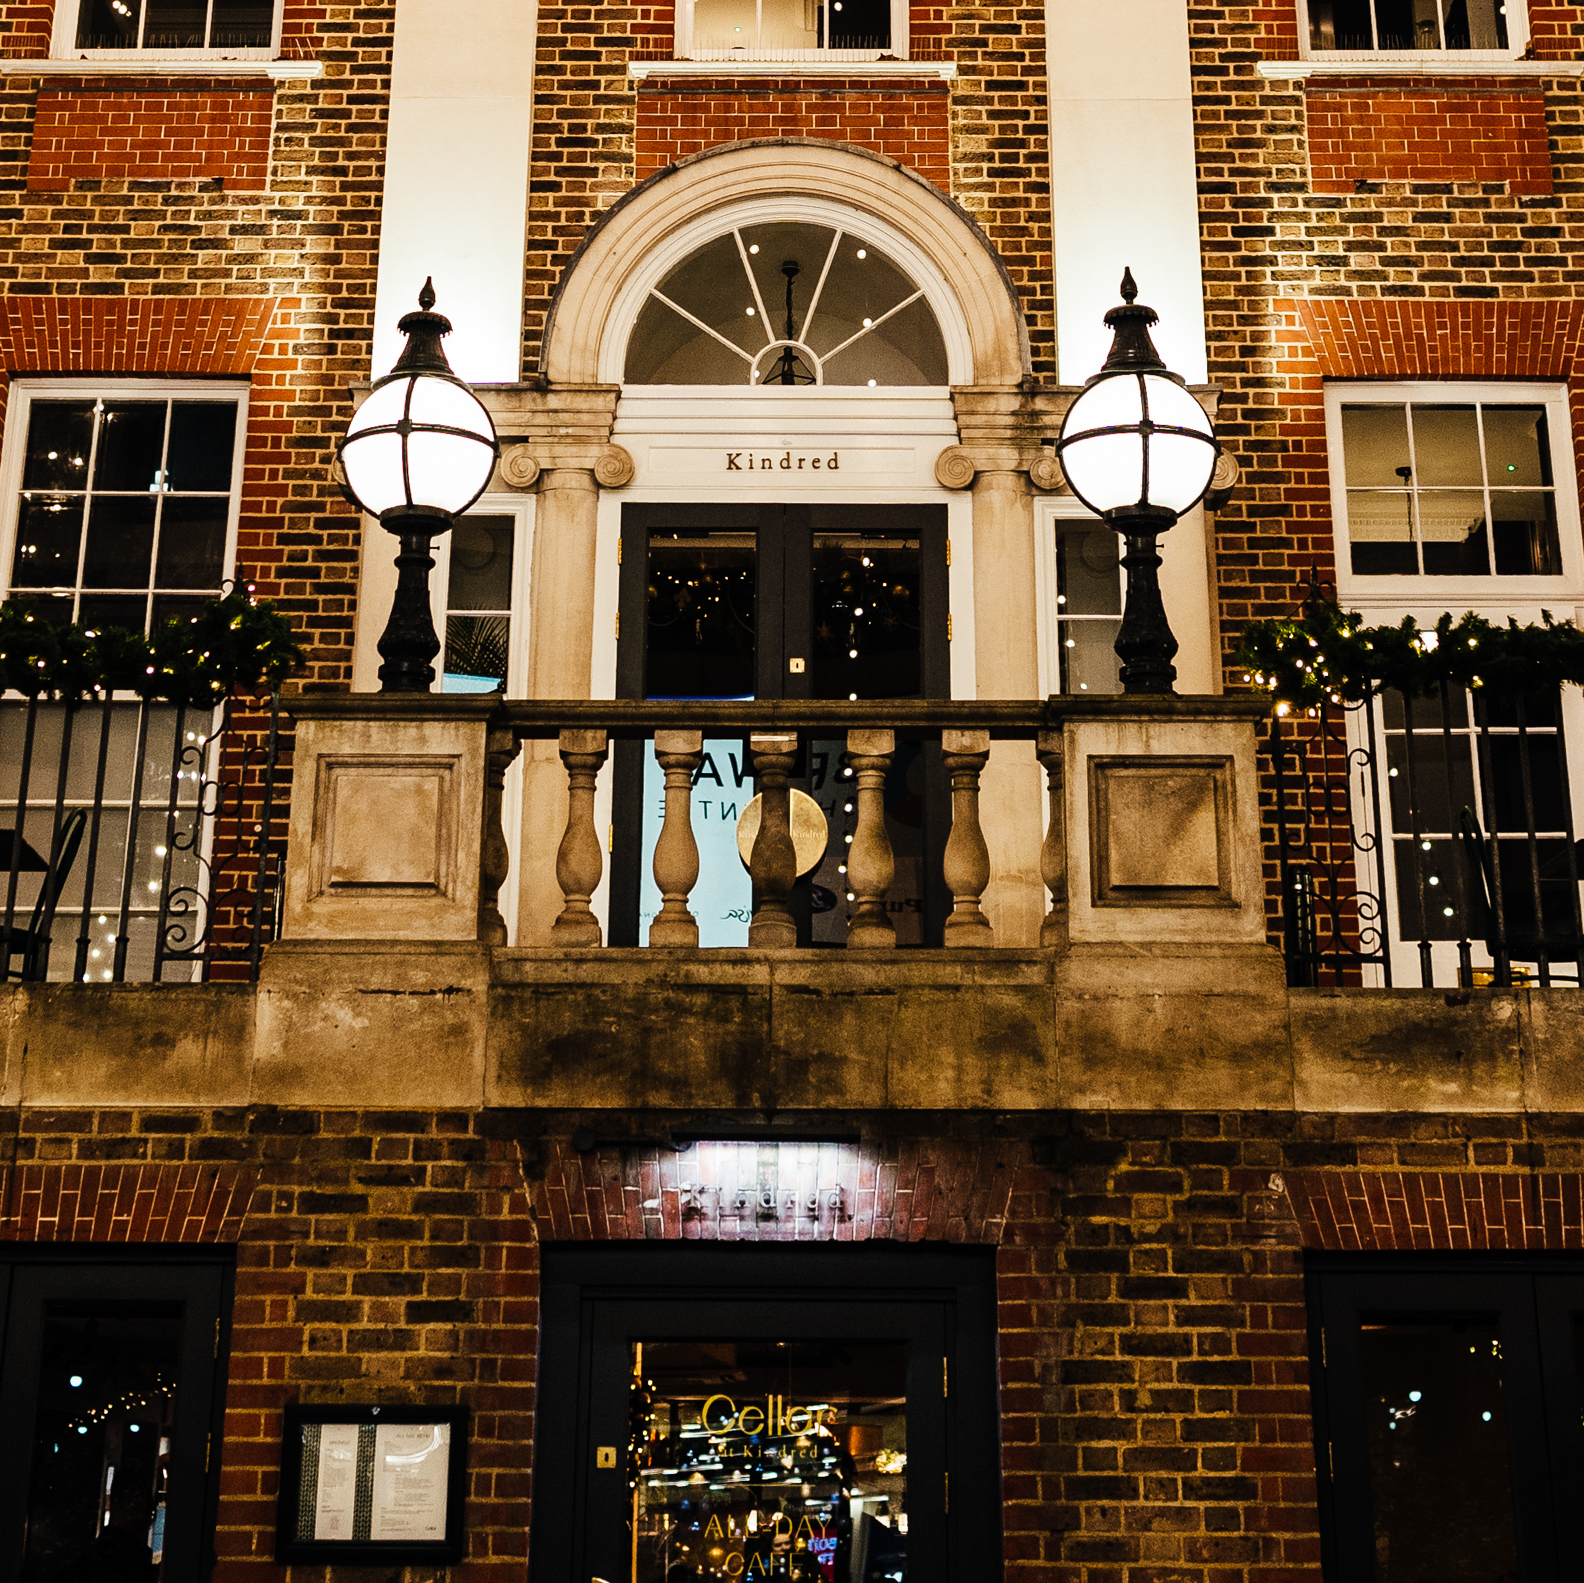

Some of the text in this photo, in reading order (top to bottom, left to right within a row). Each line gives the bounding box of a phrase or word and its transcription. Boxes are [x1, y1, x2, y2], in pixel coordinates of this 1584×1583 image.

[726, 451, 840, 470] Kindred
[792, 830, 826, 839] Kindred
[685, 1181, 844, 1209] Kindred
[702, 1394, 838, 1436] Cellar
[703, 1513, 833, 1539] ALL-DAY
